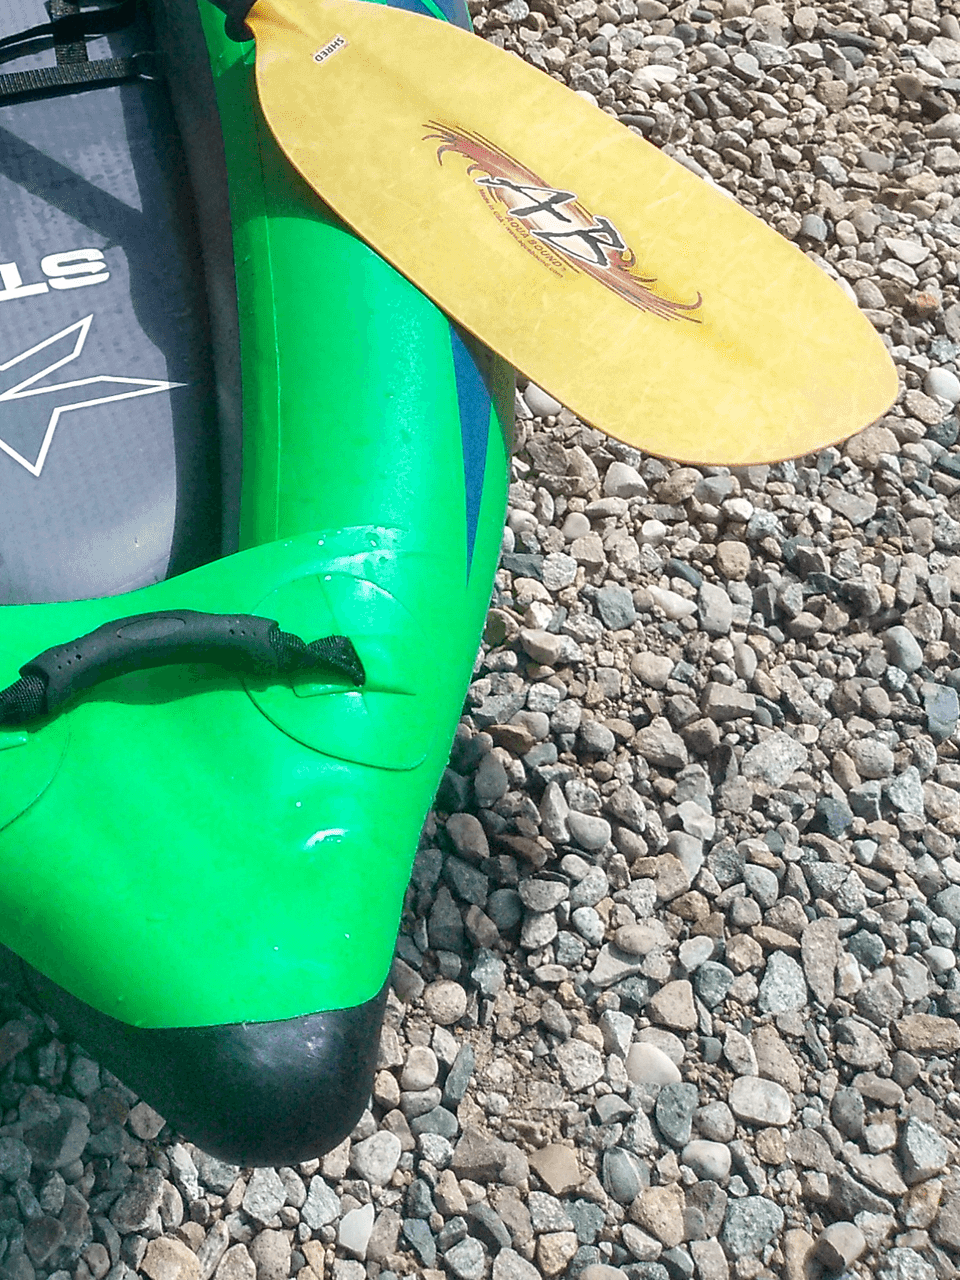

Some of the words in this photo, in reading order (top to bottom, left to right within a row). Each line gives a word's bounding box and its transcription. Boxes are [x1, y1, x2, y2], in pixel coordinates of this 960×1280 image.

[314, 37, 344, 62] SHRED
[505, 216, 529, 239] AQUA
[528, 239, 562, 268] BOUND
